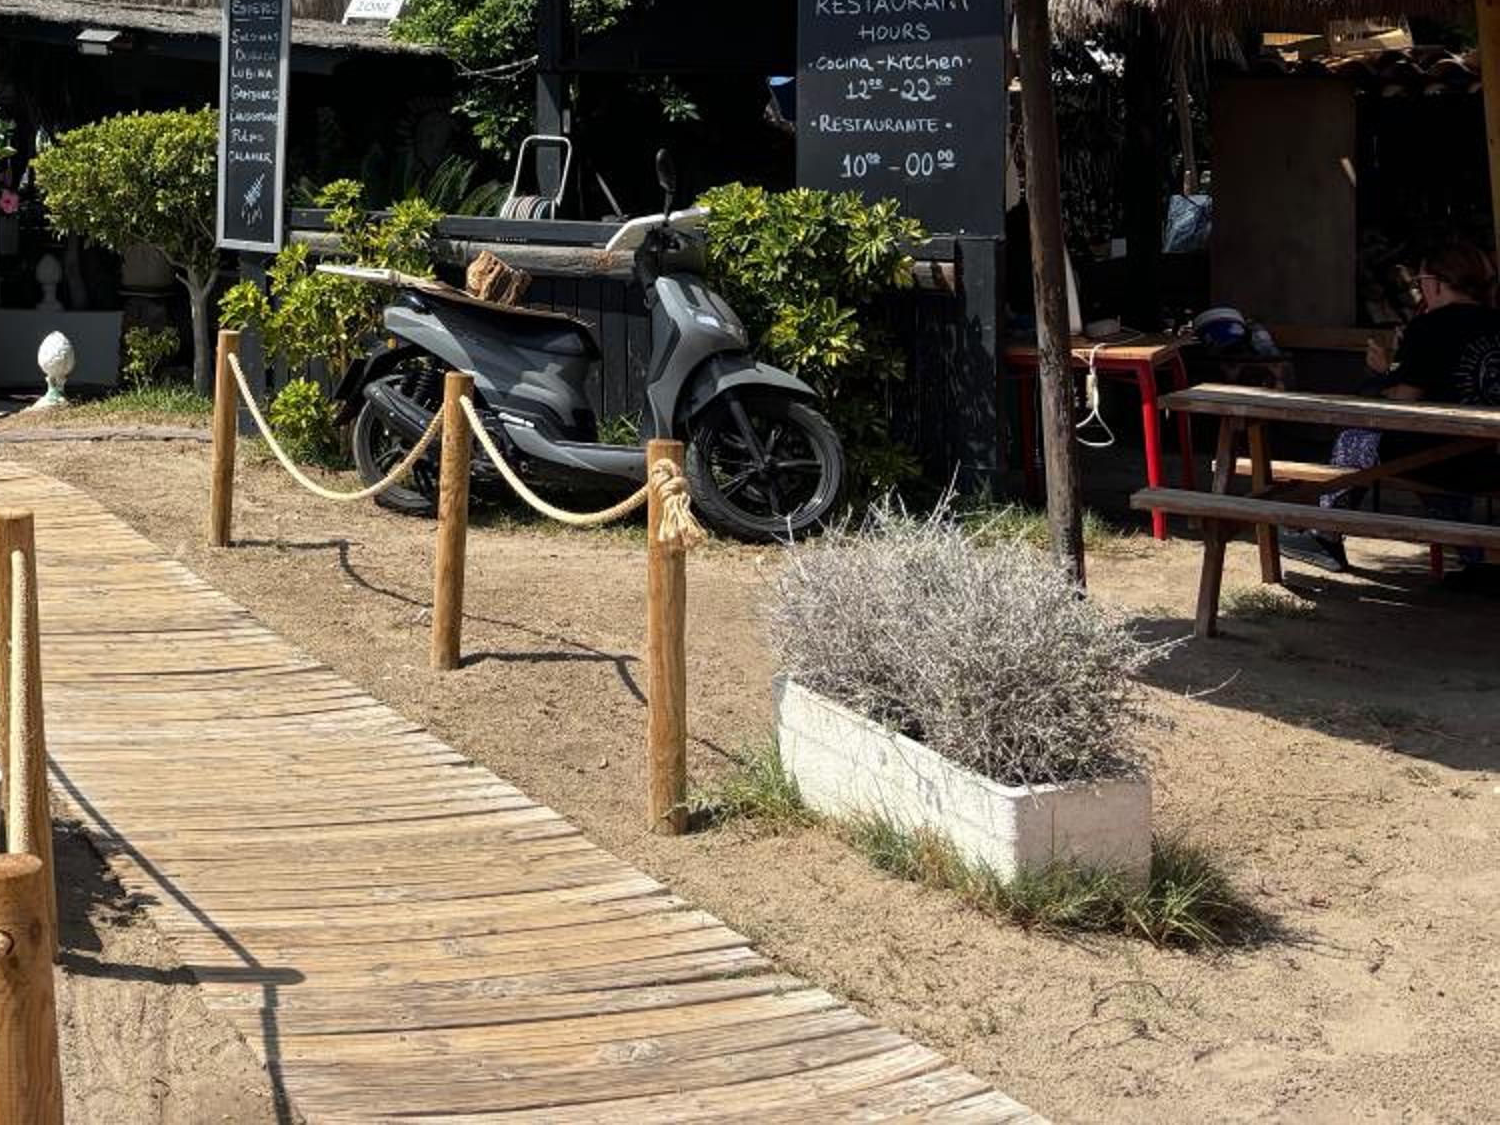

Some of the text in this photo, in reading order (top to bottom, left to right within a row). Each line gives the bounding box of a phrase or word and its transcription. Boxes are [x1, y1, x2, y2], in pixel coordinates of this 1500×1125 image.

[858, 23, 931, 42] HOURS
[816, 56, 874, 71] Cocina
[887, 53, 963, 70] Kitchen
[819, 114, 939, 132] RESTAURANTE
